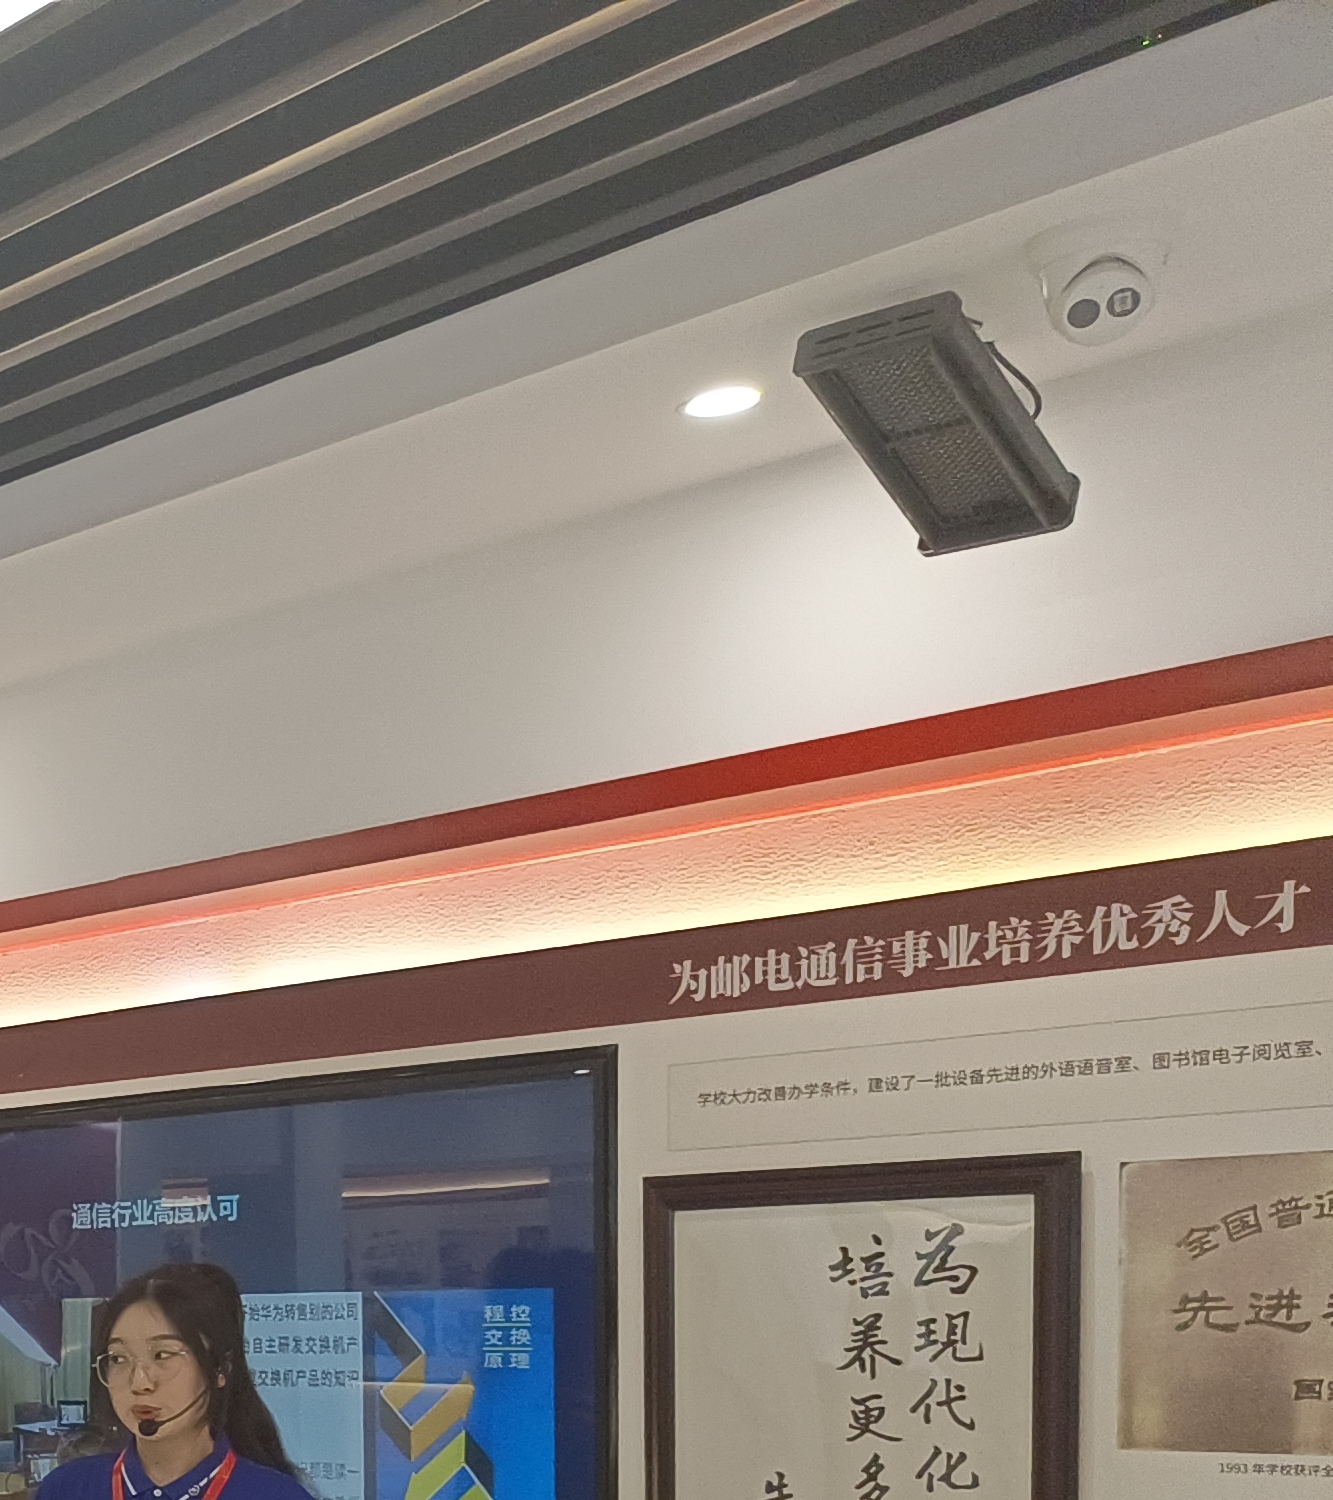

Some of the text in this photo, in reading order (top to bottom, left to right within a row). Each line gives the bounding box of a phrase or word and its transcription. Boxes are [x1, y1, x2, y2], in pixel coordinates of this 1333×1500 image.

[668, 879, 1311, 1004] 为邮电通信事业培养优秀人才
[72, 1194, 240, 1230] 通信行业高度认可
[1170, 1286, 1333, 1333] 先进
[484, 1328, 531, 1345] 交换
[484, 1353, 531, 1369] 原理
[250, 1367, 360, 1389] 交换机产品的知识
[1293, 1379, 1333, 1401] 国
[1219, 1463, 1248, 1474] 1993
